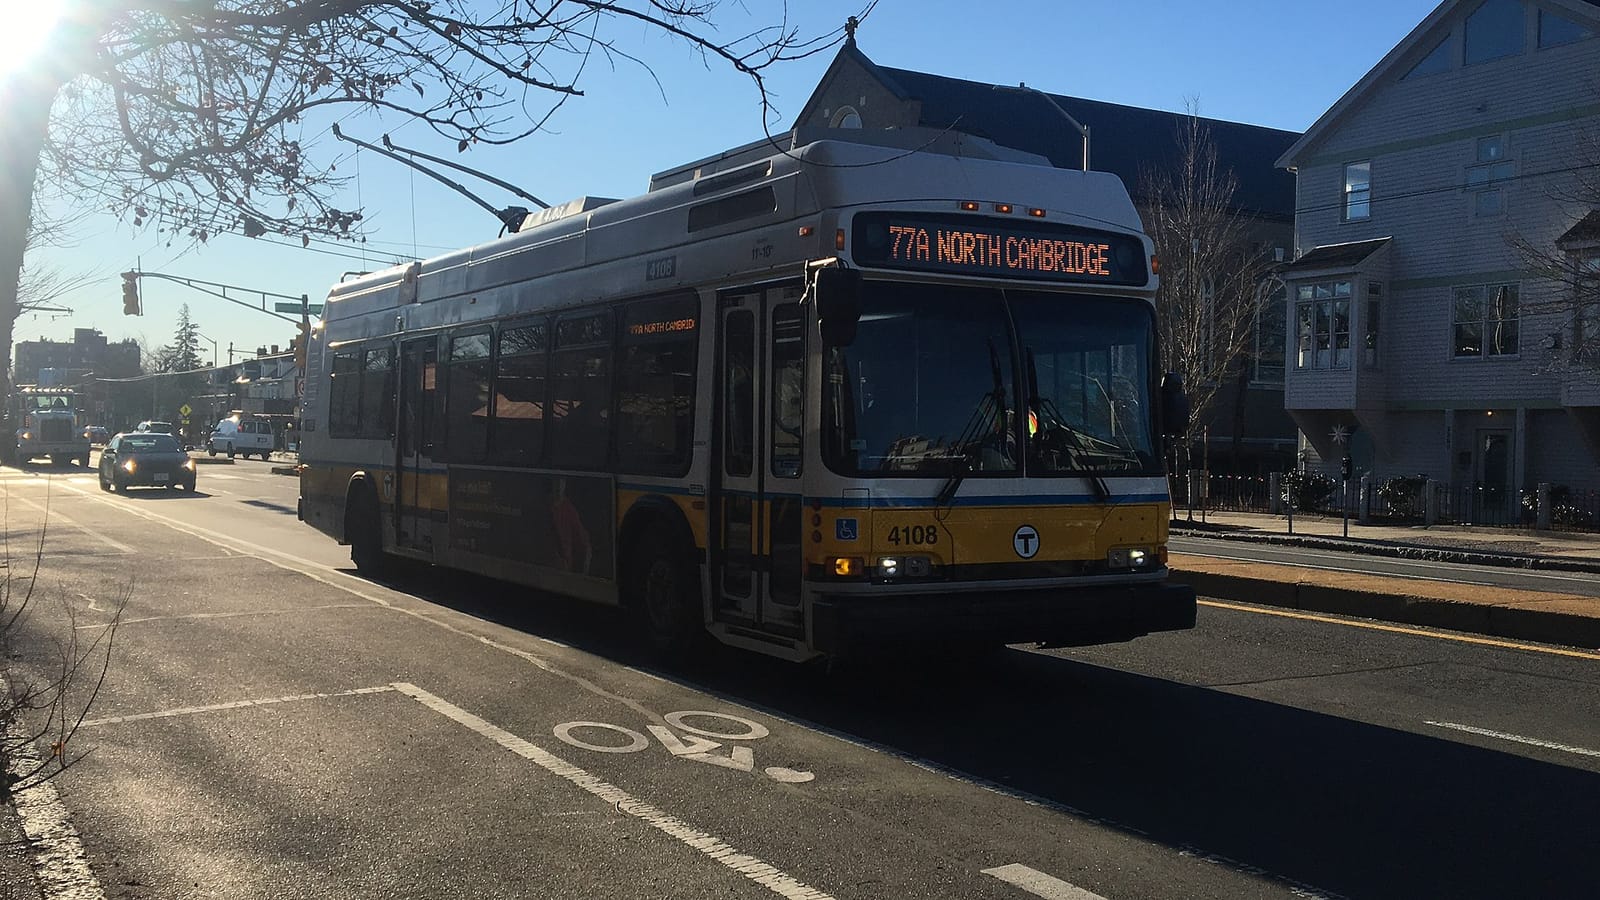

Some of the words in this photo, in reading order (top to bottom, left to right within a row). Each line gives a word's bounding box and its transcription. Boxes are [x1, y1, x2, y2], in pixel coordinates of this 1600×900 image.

[889, 225, 931, 262] 77A
[936, 229, 1001, 267] NORTH
[1005, 236, 1110, 276] CAMBRIDGE
[649, 259, 672, 280] 4108
[645, 322, 664, 335] NORTH
[887, 525, 938, 546] 4108
[1017, 533, 1036, 555] T
